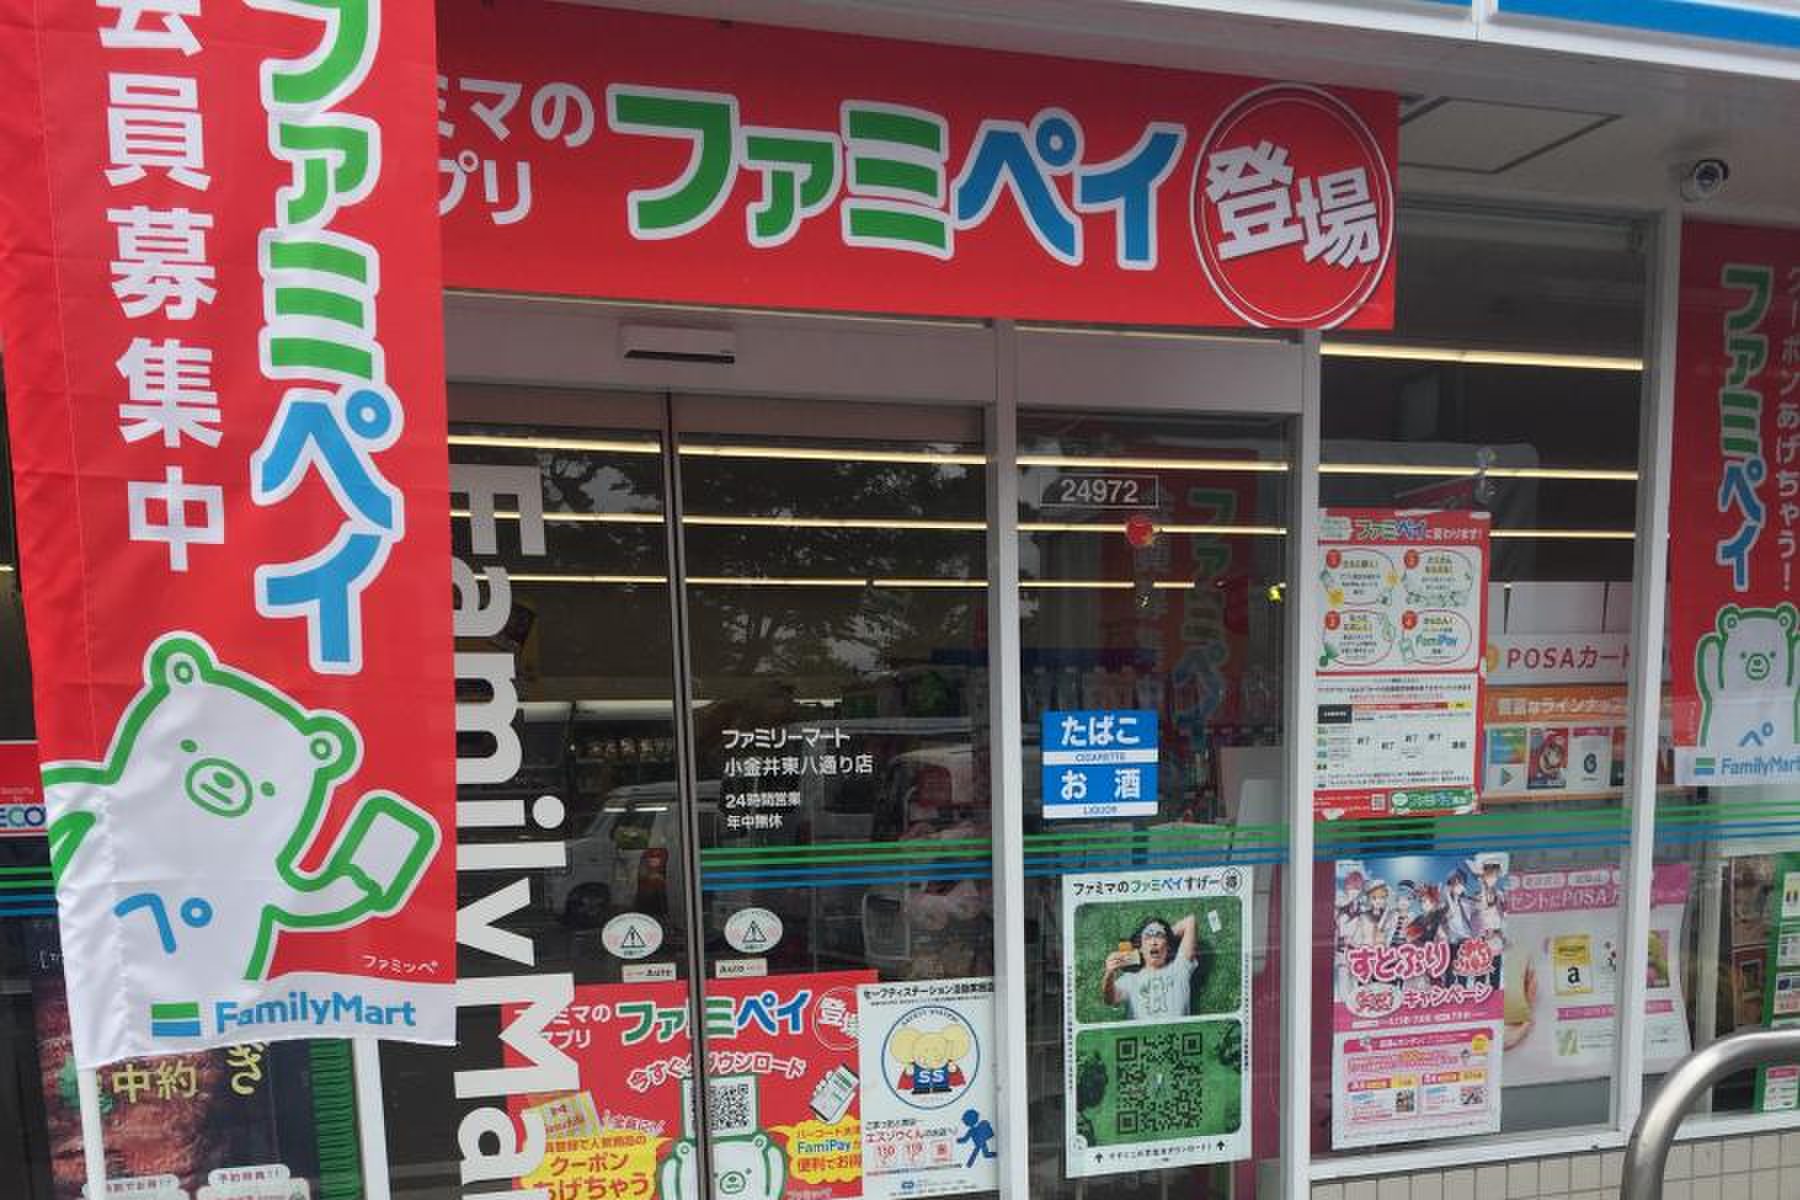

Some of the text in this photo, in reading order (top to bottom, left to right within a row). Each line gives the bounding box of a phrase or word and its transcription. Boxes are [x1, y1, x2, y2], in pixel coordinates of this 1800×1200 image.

[605, 82, 1187, 272] ファミペイ
[1202, 138, 1382, 270] 登場
[248, 0, 405, 676] ファミペイ
[1715, 263, 1774, 593] ファミペイ
[1060, 479, 1140, 503] 24972
[721, 727, 851, 750] ファミリーマート
[1060, 716, 1141, 747] たばこ
[724, 754, 874, 778] 小金井東八通り店
[725, 791, 801, 809] 24時間営業
[726, 813, 784, 831] 年中無休
[215, 991, 417, 1034] FamilyMart
[616, 990, 812, 1046] ファミペイ
[550, 1151, 630, 1177] クーポン
